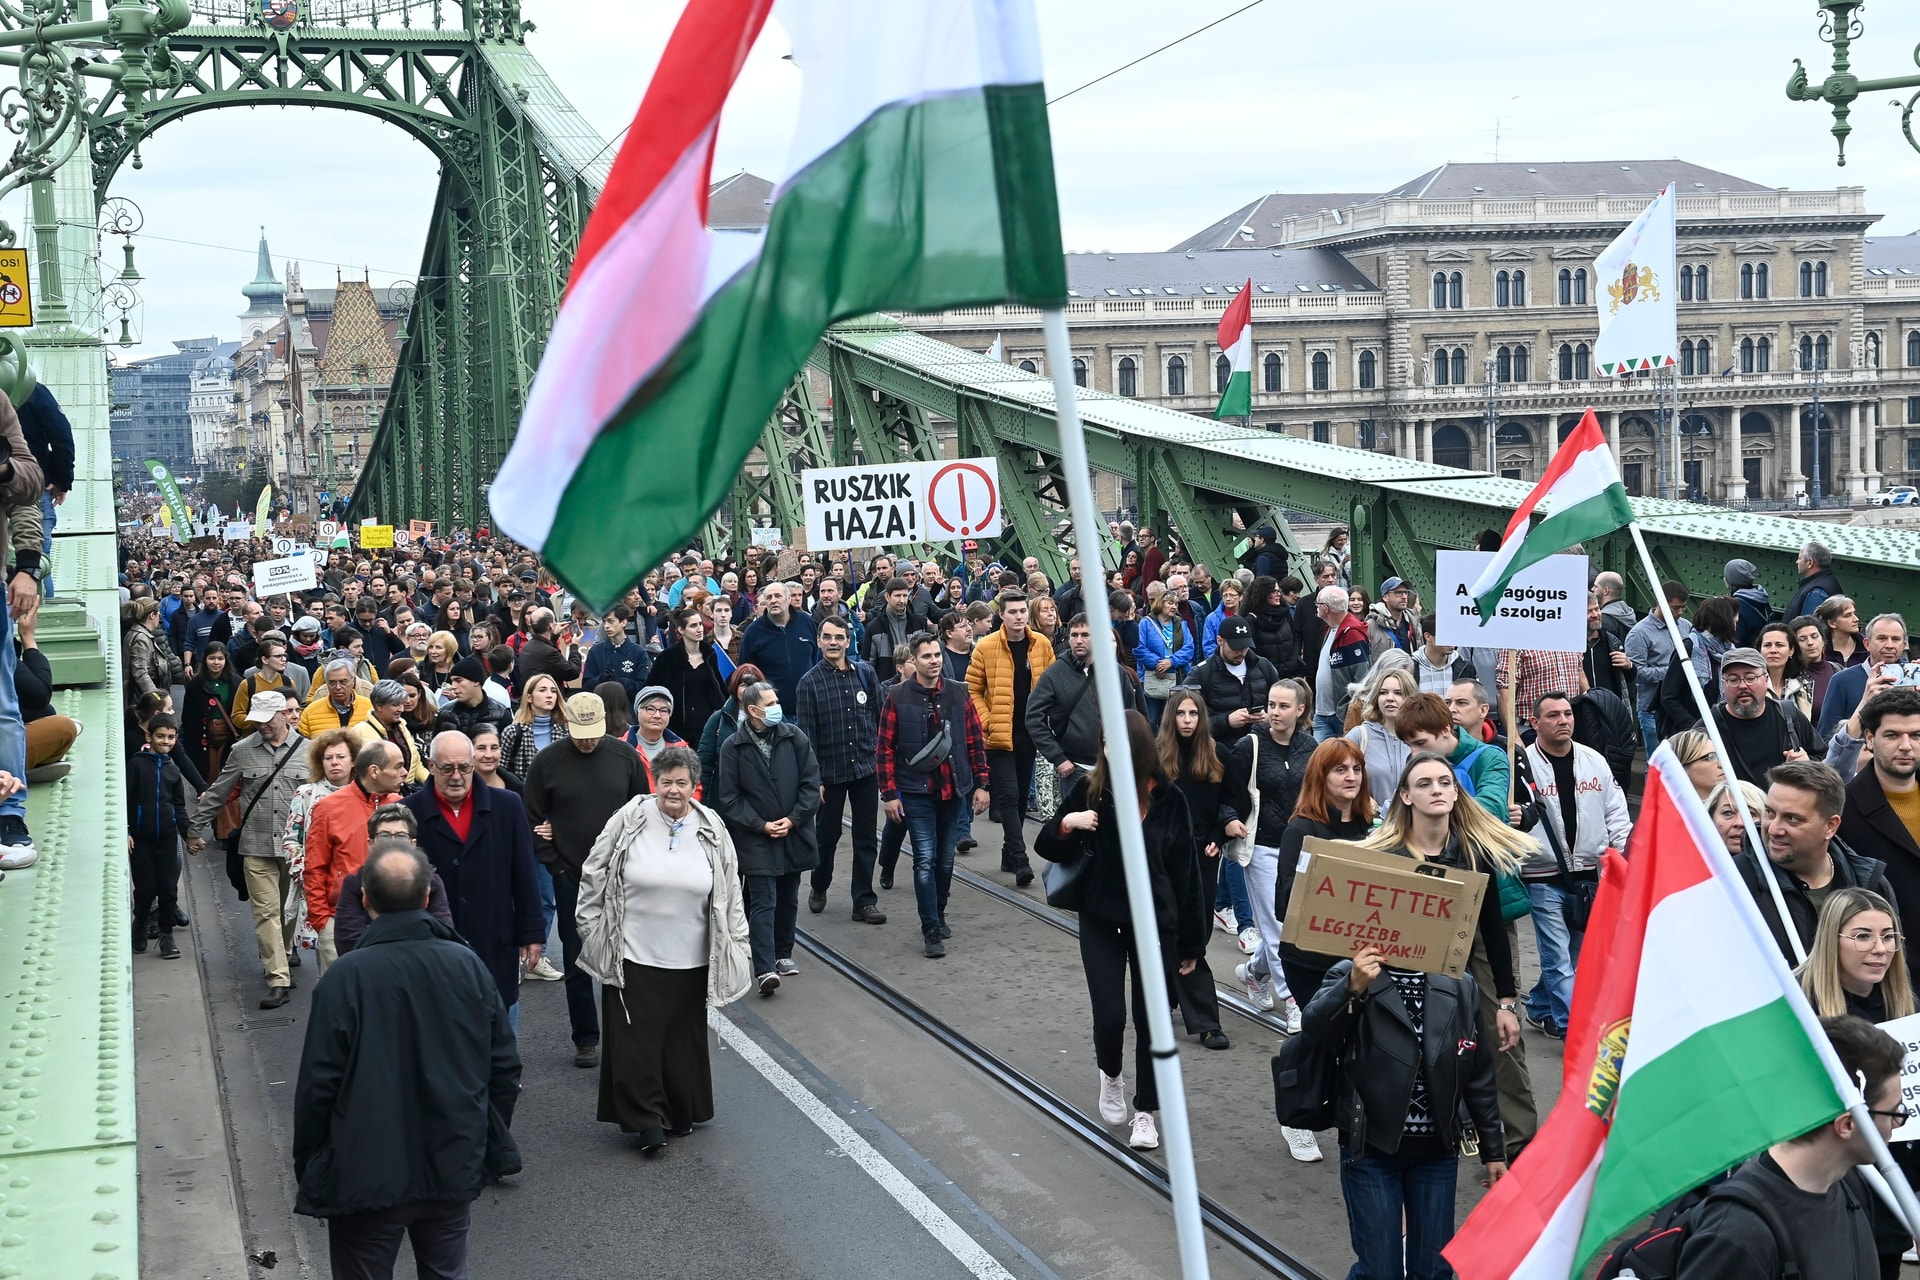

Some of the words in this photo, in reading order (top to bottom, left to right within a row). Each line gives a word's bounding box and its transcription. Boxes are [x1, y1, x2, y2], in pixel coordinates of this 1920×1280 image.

[814, 472, 912, 504] RUSZKIK
[824, 501, 917, 542] HAZA!
[1456, 583, 1468, 596] A
[1502, 585, 1568, 601] agógus
[1500, 606, 1562, 622] szolga!
[1316, 875, 1335, 898] A
[1346, 879, 1454, 920] TETTEK
[1308, 915, 1401, 942] LEGSZEBB
[1366, 910, 1382, 925] A
